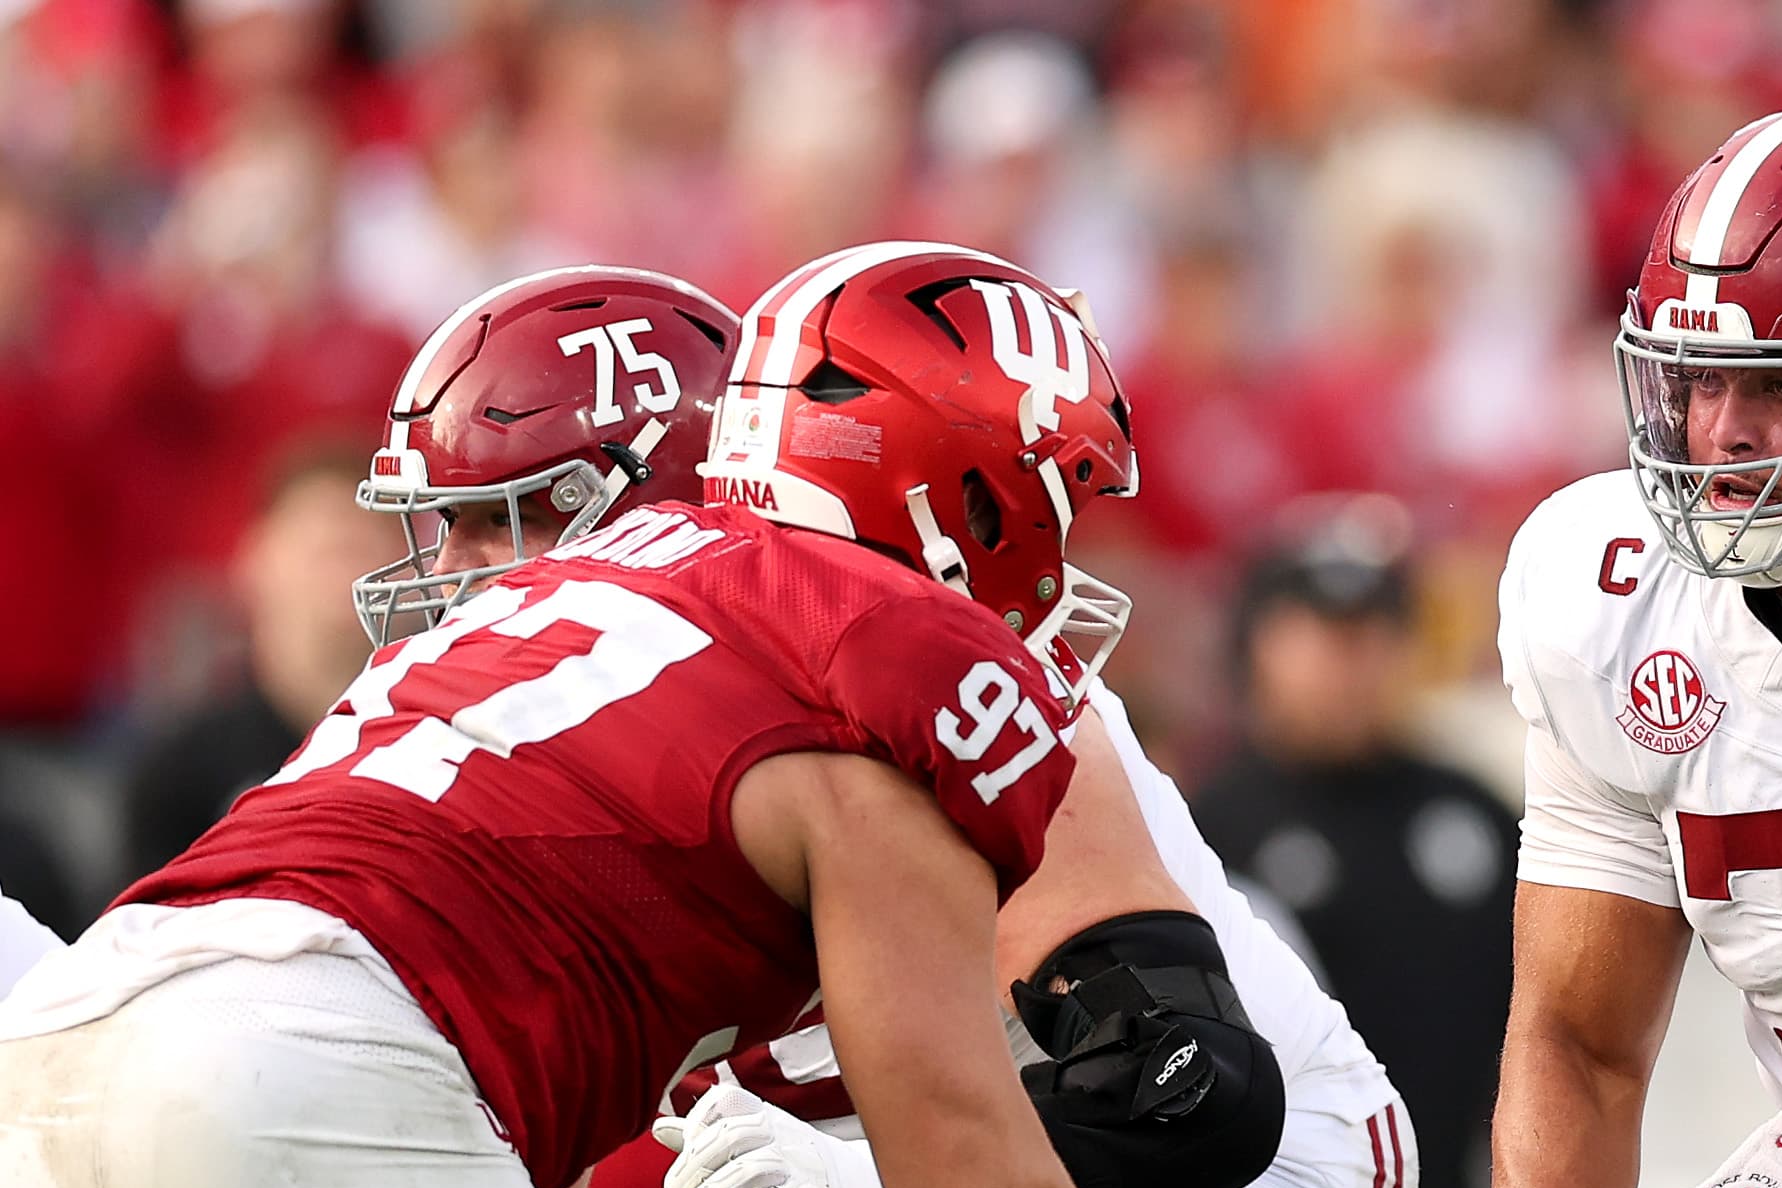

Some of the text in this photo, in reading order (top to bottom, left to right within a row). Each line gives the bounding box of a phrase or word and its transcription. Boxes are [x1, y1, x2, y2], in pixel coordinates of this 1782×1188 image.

[1669, 306, 1719, 333] BAMA
[556, 317, 682, 428] 75
[374, 456, 401, 475] AMA
[704, 476, 779, 512] DIANA
[1597, 537, 1646, 597] C
[262, 579, 715, 804] 97
[1633, 653, 1699, 727] SEC
[934, 660, 1059, 806] 97
[1632, 716, 1711, 752] GRADUATE
[1154, 1038, 1199, 1086] DONJOY
